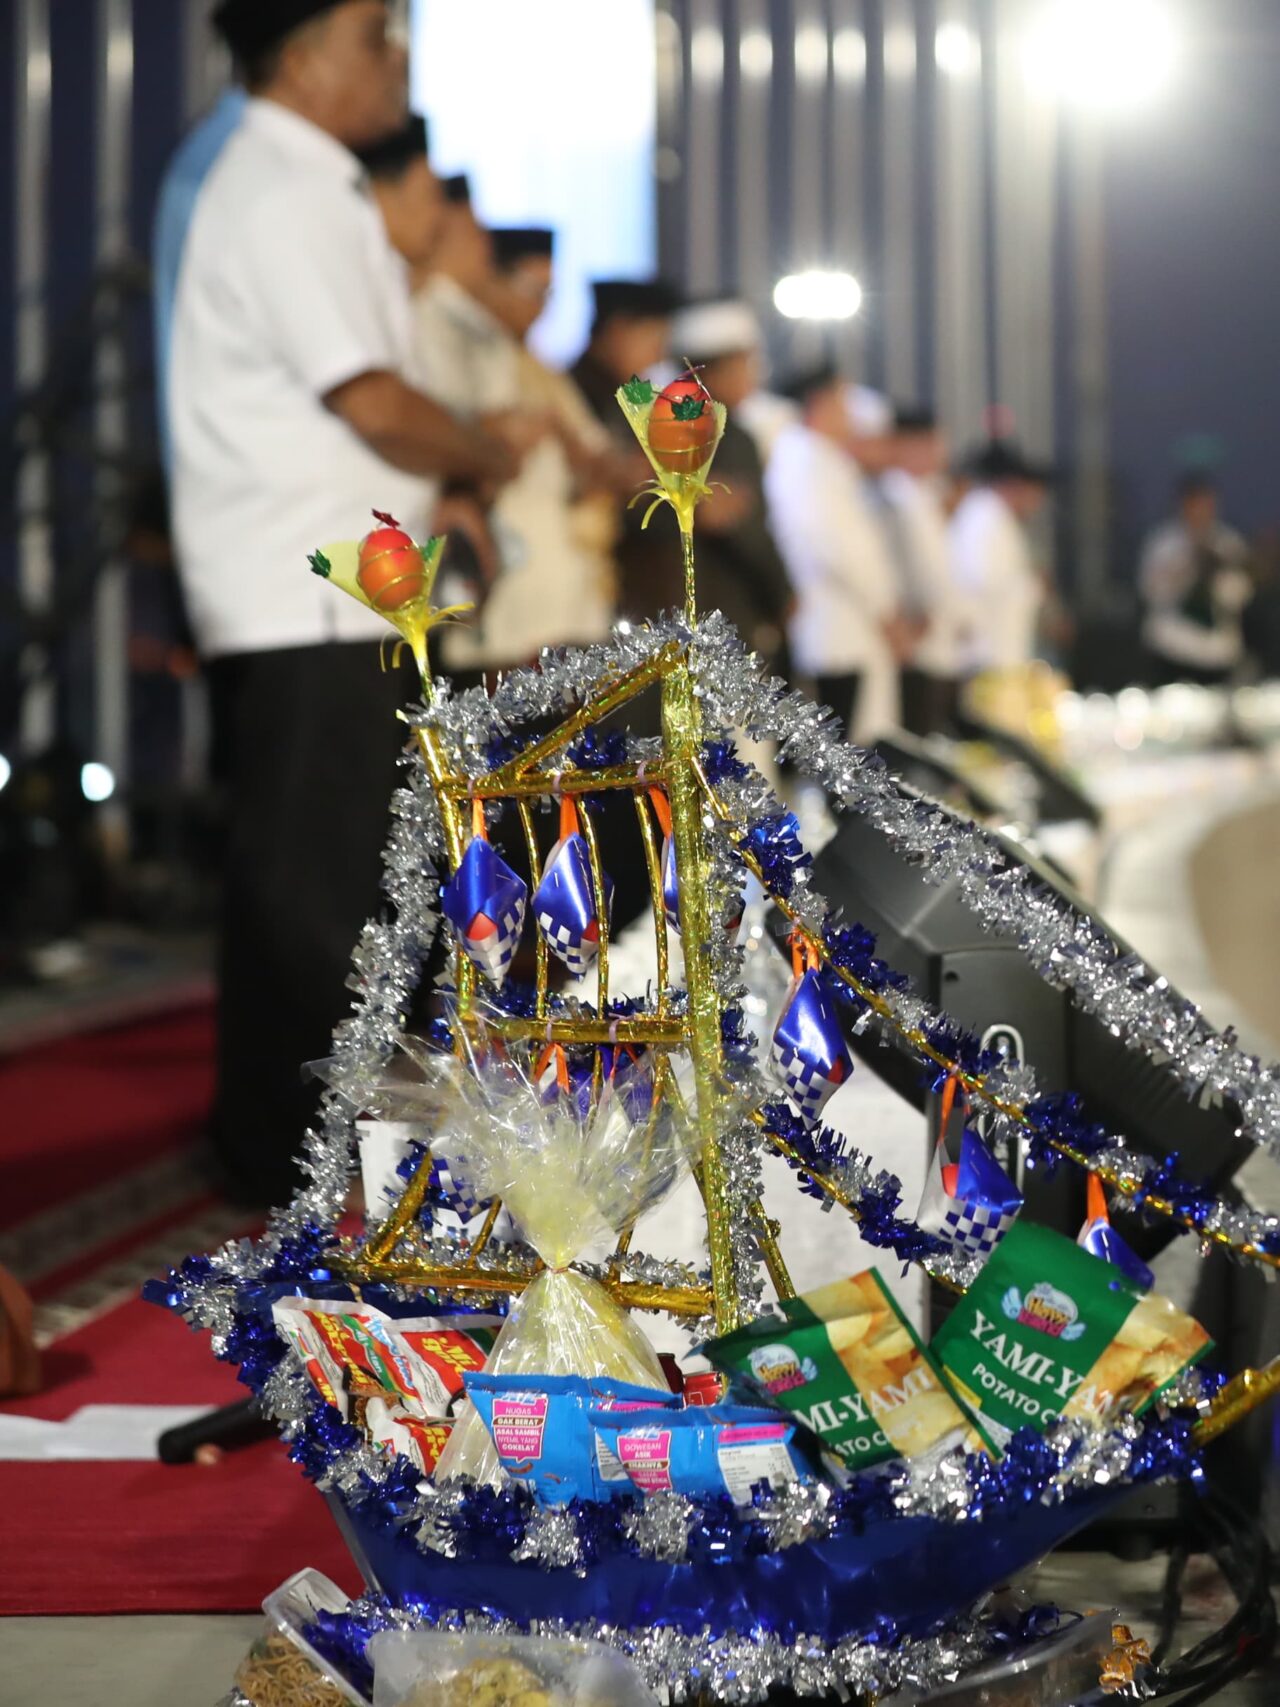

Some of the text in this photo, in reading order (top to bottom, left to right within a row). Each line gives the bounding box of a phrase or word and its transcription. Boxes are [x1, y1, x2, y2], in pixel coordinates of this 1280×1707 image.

[969, 1309, 1116, 1415] YAMI-YAM
[972, 1363, 1040, 1415] POTATO
[791, 1367, 934, 1433] MI-YAMI
[505, 1407, 532, 1416] NUGAS
[496, 1428, 540, 1436] ASAL SAMBIL
[497, 1418, 539, 1427] GAK BERAT
[834, 1436, 871, 1457] ATO
